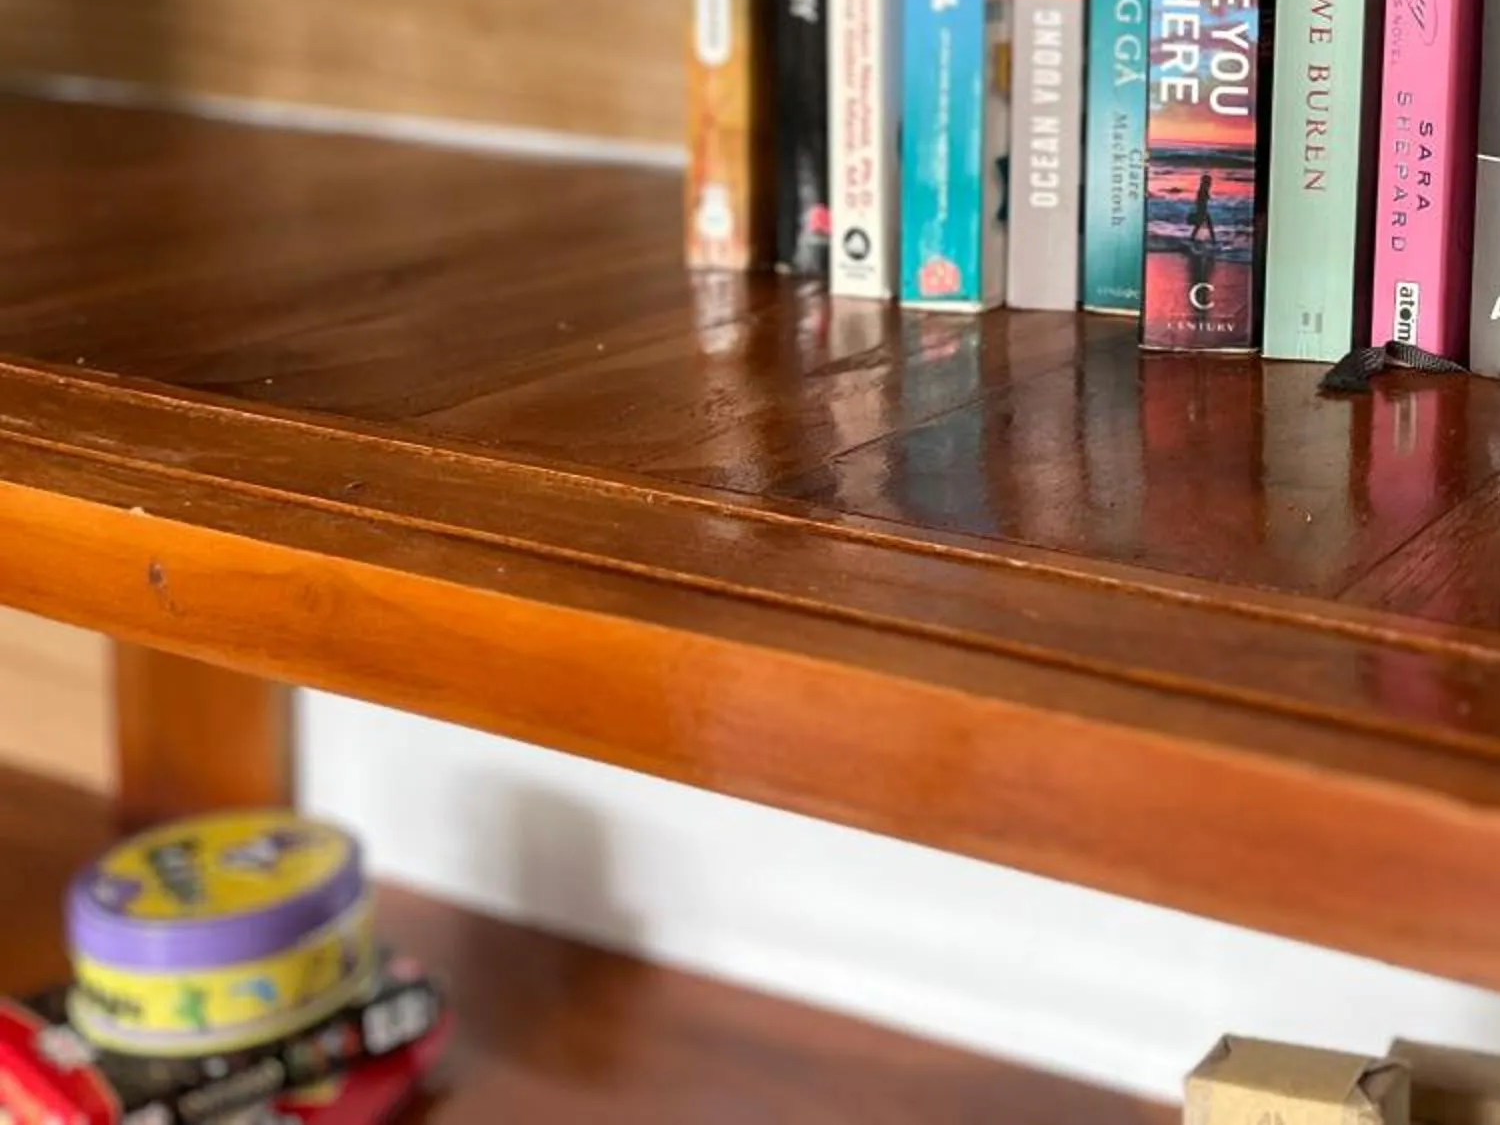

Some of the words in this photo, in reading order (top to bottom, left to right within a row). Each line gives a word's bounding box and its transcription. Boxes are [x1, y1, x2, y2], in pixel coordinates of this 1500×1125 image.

[1032, 9, 1064, 105] VUONG
[1114, 34, 1145, 87] GÅ
[1209, 23, 1250, 116] YOU
[1030, 116, 1060, 209] OCEAN
[1111, 111, 1129, 228] Mackintosh
[1127, 147, 1145, 201] Clare
[1303, 64, 1332, 193] BUREN
[1391, 90, 1412, 253] SHEPARD
[1415, 120, 1434, 212] SARA
[1167, 321, 1236, 333] CENTURY
